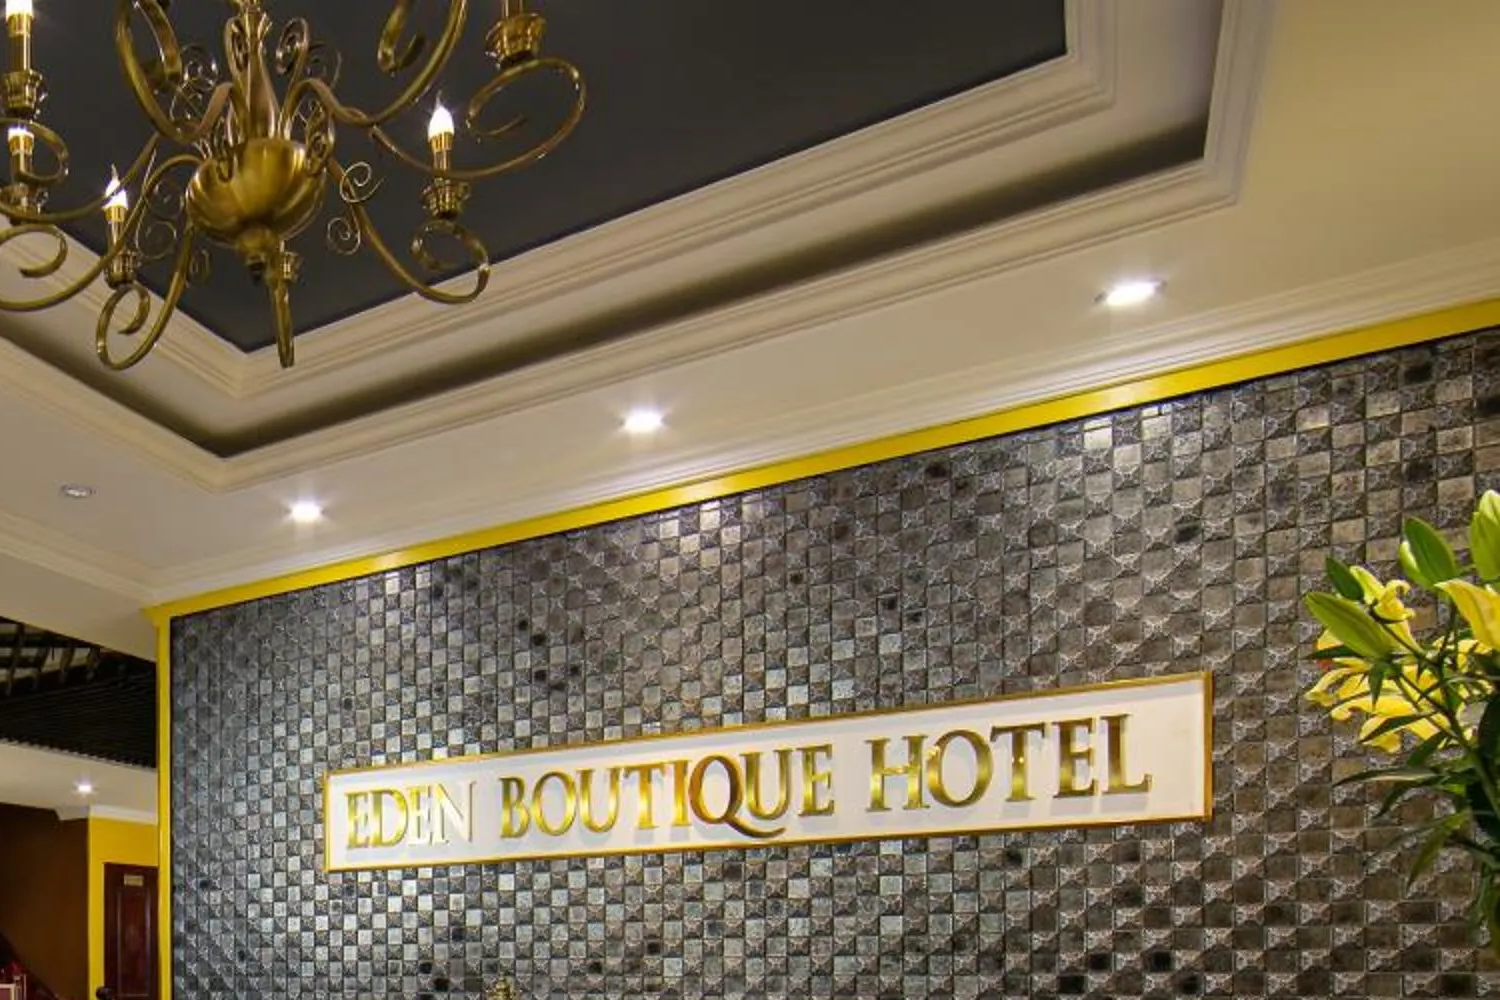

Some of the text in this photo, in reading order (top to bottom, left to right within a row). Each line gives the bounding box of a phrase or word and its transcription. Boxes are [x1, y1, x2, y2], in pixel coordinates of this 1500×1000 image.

[345, 714, 1152, 849] EDEN BOUTIQUE HOTEL
